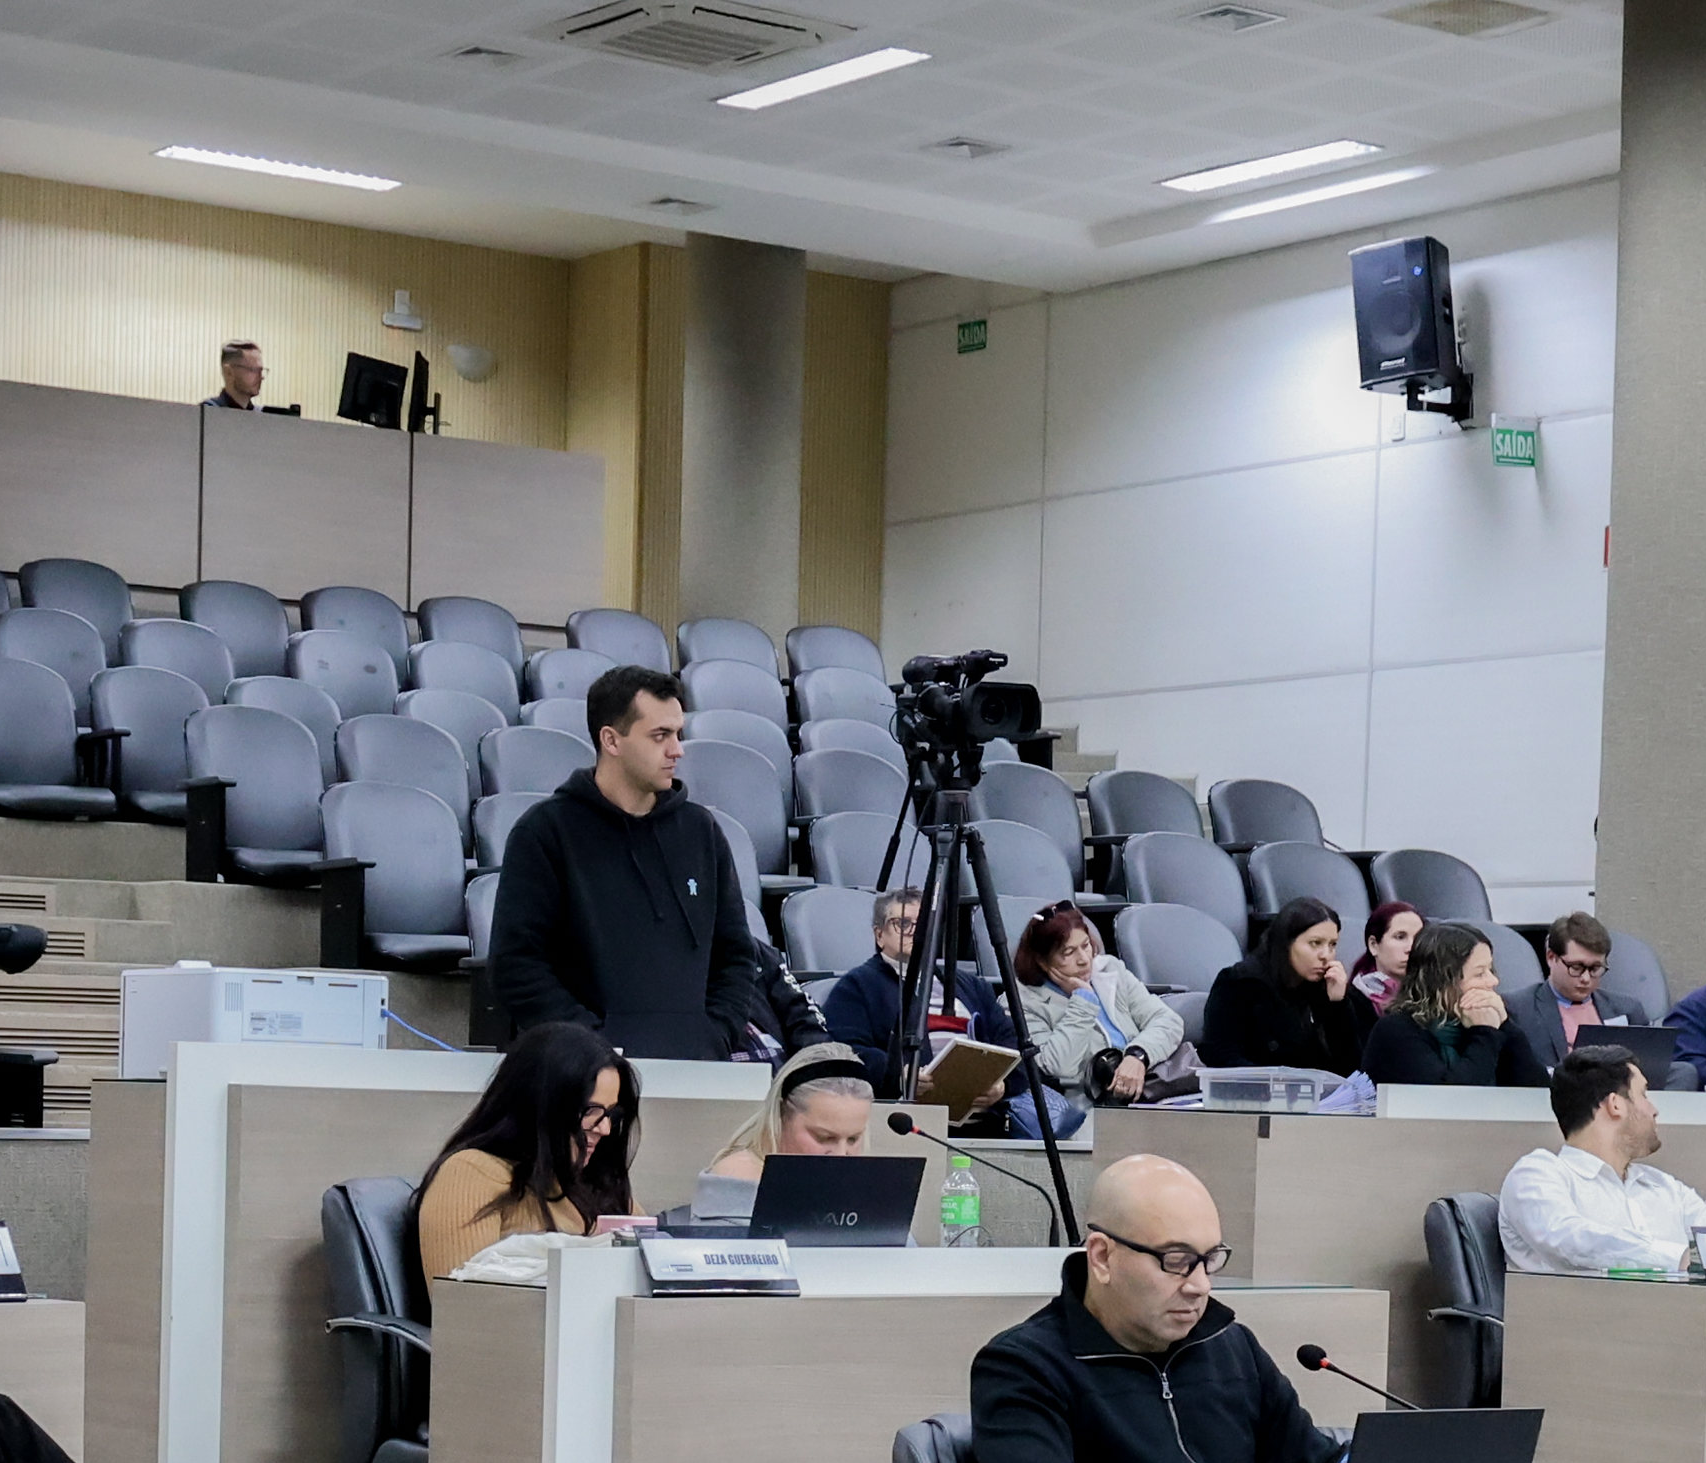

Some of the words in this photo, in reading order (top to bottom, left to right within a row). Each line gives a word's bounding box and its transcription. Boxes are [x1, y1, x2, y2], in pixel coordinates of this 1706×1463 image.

[1495, 430, 1535, 459] SAÍDA
[704, 1253, 727, 1265] DEZA
[728, 1253, 779, 1266] GUERREIRO
